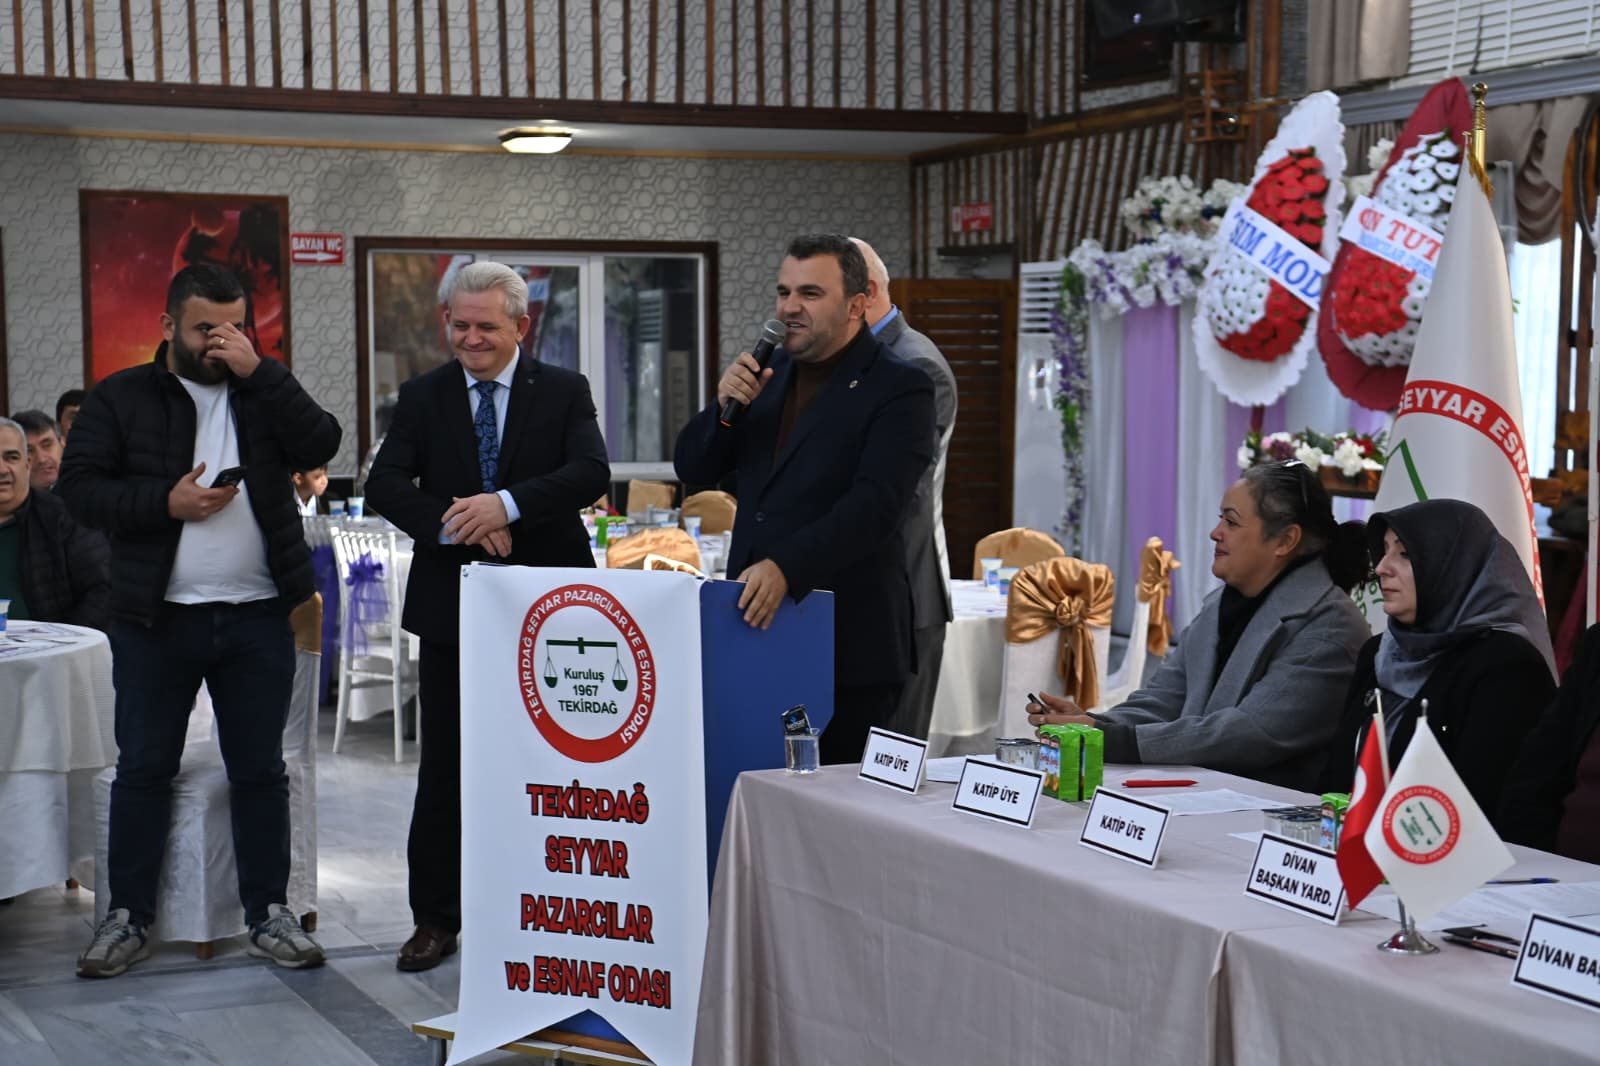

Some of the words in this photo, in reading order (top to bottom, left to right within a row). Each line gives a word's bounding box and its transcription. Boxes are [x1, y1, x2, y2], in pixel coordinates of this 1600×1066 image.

[292, 237, 325, 250] BAYAN
[326, 237, 343, 252] WC
[527, 594, 562, 635] SEYYAR
[564, 590, 629, 630] PAZARCILAR
[627, 626, 642, 648] VE
[521, 637, 543, 719] TEKİRDAĞ
[564, 667, 605, 683] Kuruluş
[572, 685, 599, 697] 1967
[637, 649, 652, 703] ESNAF
[558, 698, 618, 715] TEKİRDAĞ
[620, 703, 649, 744] ODASI
[873, 751, 894, 768] KATİP
[893, 755, 909, 772] ÜYE
[526, 779, 650, 824] TEKİRDAĞ
[972, 781, 1000, 798] KATİP
[1000, 785, 1020, 804] ÜYE
[1100, 814, 1126, 834] KATİP
[1125, 819, 1146, 841] ÜYE
[545, 835, 630, 879] SEYYAR
[1282, 850, 1317, 875] DİVAN
[1256, 868, 1299, 895] BAŞKAN
[1300, 881, 1332, 906] YARD.
[520, 893, 654, 944] PAZARCILAR
[504, 961, 531, 992] ve
[533, 955, 605, 999] ESNAF
[608, 963, 672, 1009] ODASI
[1527, 940, 1575, 970] DİVAN
[1576, 955, 1600, 985] BA
